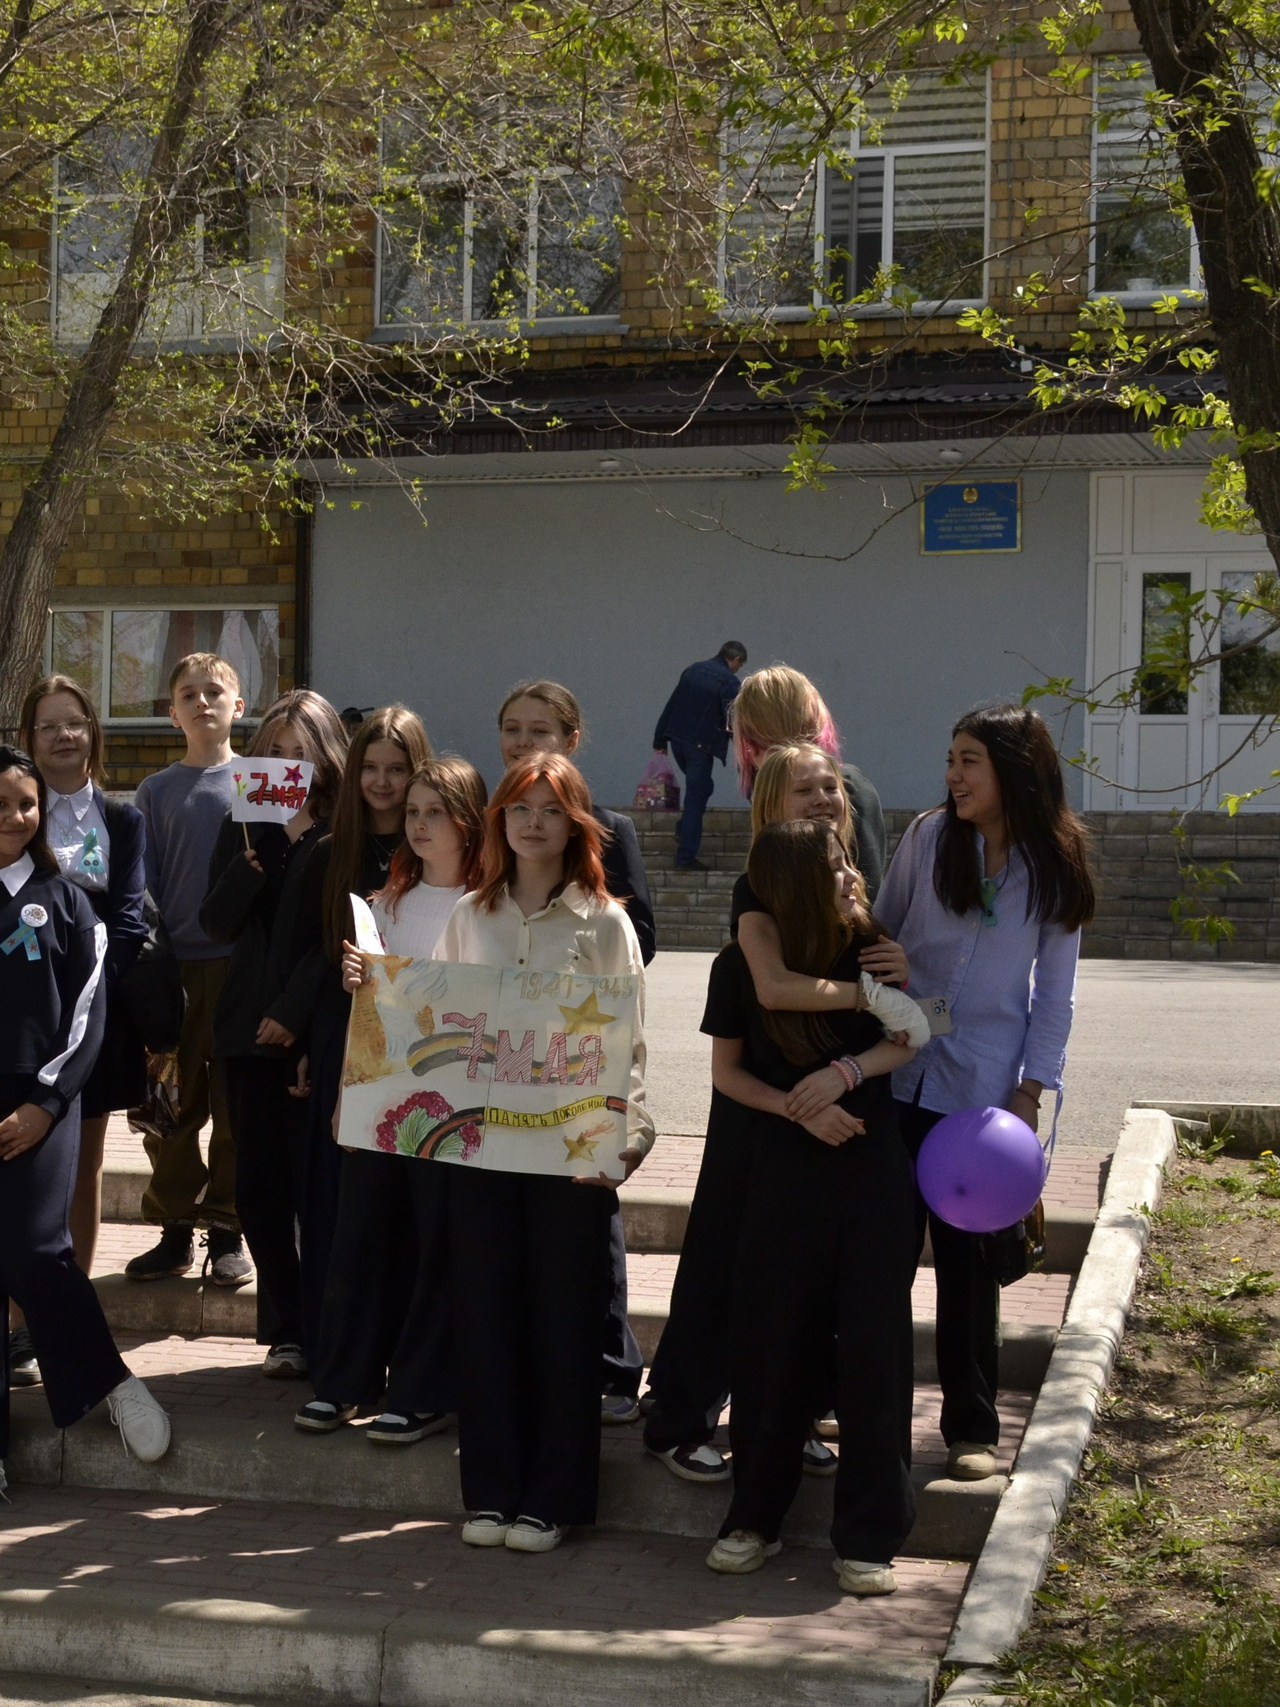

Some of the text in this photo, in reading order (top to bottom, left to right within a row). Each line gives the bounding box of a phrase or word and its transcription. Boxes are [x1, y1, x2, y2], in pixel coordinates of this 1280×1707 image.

[250, 772, 268, 805] 7
[442, 1013, 487, 1078] 7
[494, 1030, 602, 1086] МАЯ
[489, 1108, 548, 1127] ПАМЯТЬ
